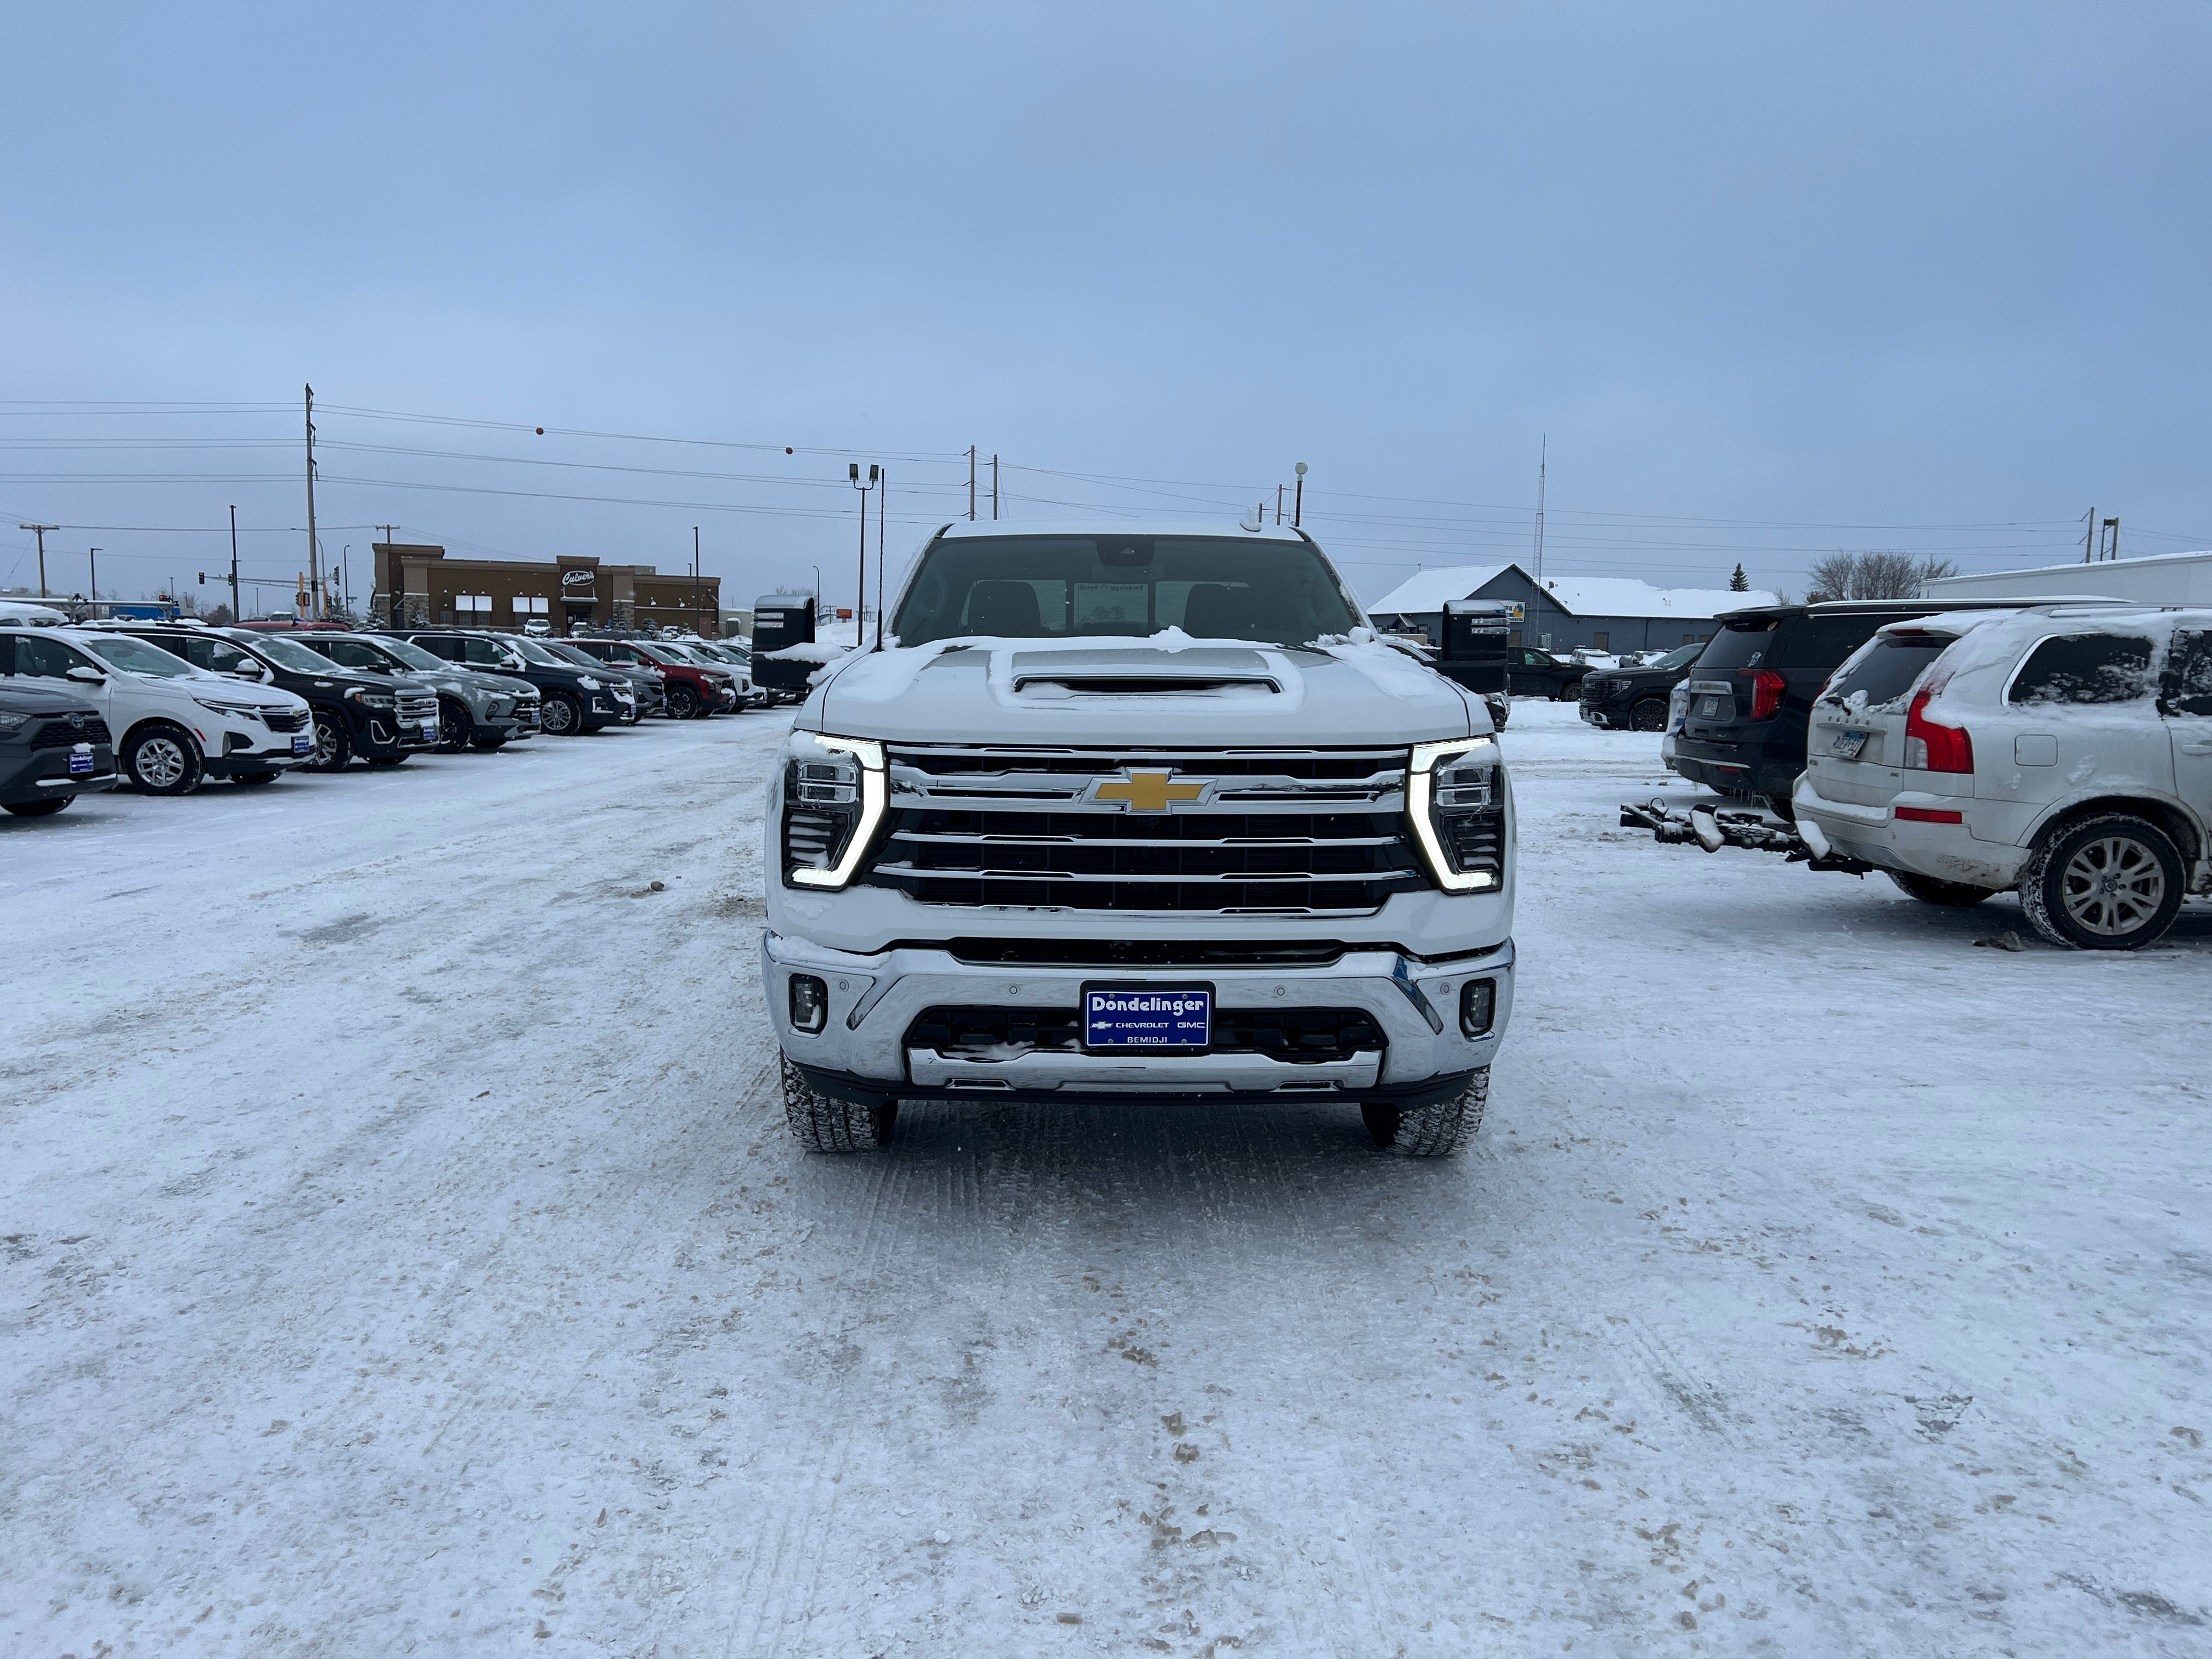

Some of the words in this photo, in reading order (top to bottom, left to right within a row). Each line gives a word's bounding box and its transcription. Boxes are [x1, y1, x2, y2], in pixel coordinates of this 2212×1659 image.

[562, 571, 594, 585] Culver's
[1829, 716, 1870, 725] VOLVO
[1092, 997, 1204, 1015] Dondelinger
